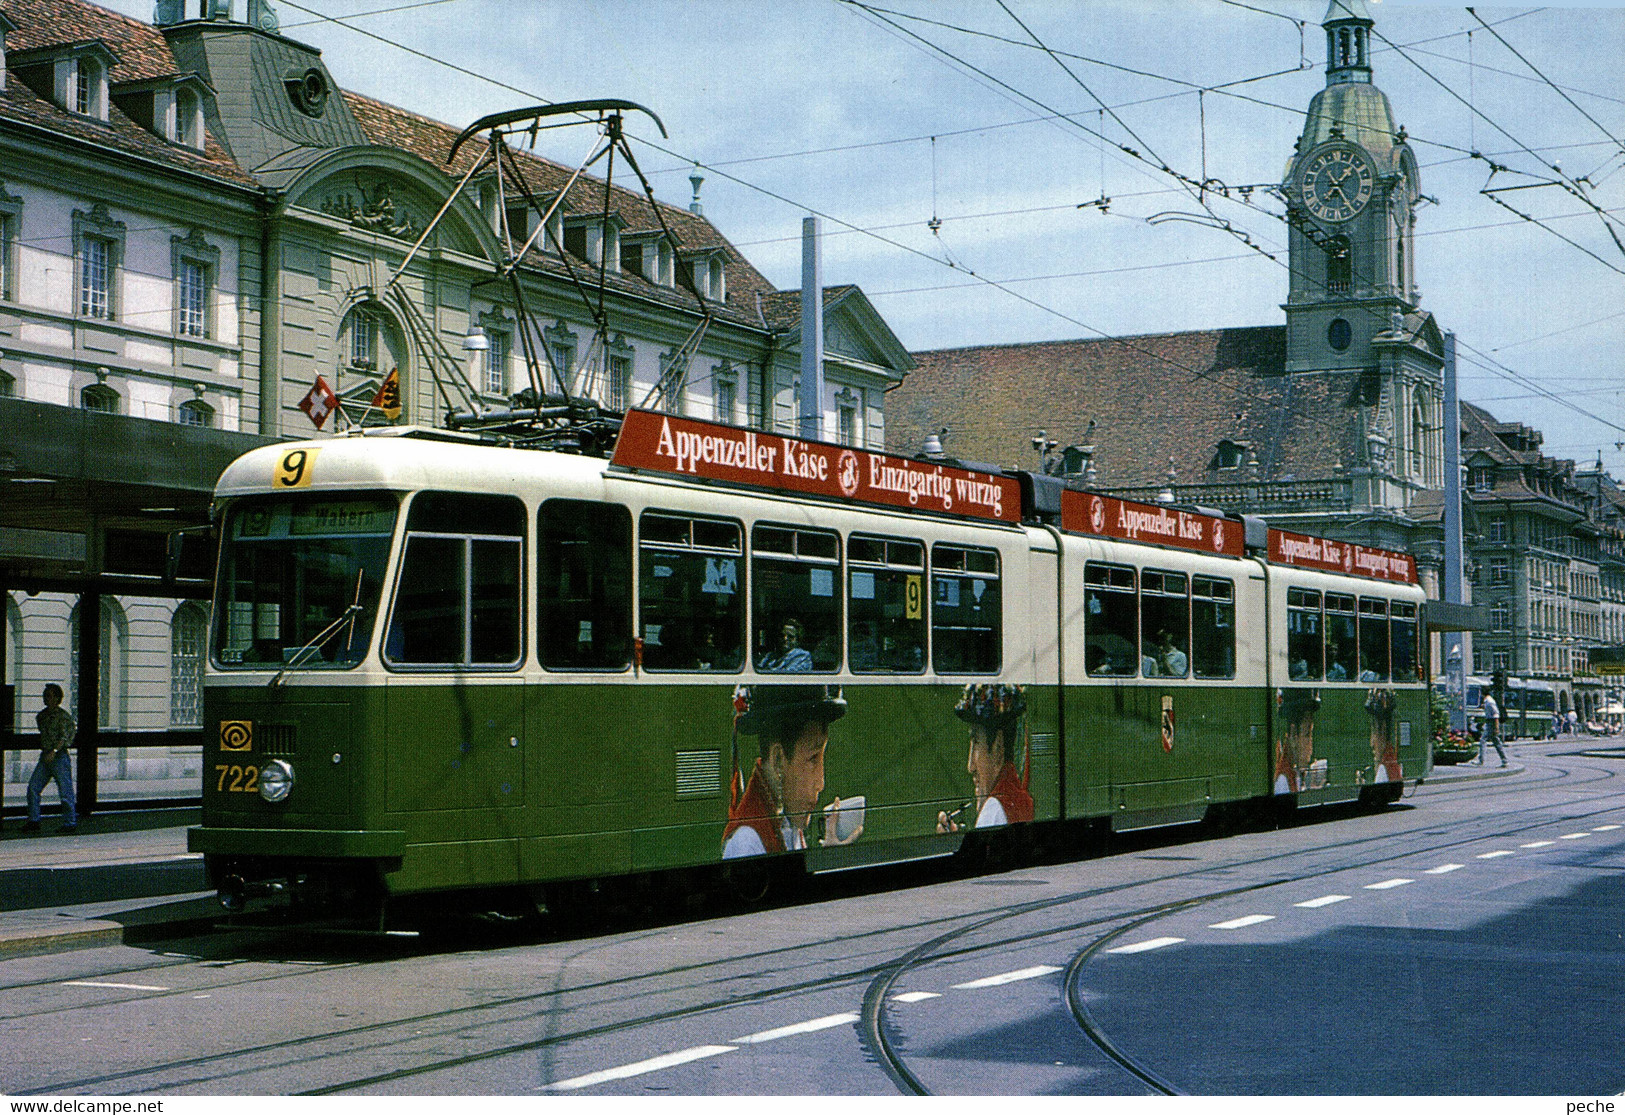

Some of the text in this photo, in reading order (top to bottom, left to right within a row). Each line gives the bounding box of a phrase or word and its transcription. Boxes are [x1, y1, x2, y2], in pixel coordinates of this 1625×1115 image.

[656, 416, 828, 481] Appenzeller Käse
[281, 450, 307, 486] 9
[868, 453, 1003, 517] Einzigartig würzig
[315, 506, 375, 527] Wabern
[1117, 501, 1203, 541] Appenzeller Käse
[908, 580, 919, 613] 9
[215, 764, 259, 792] 722
